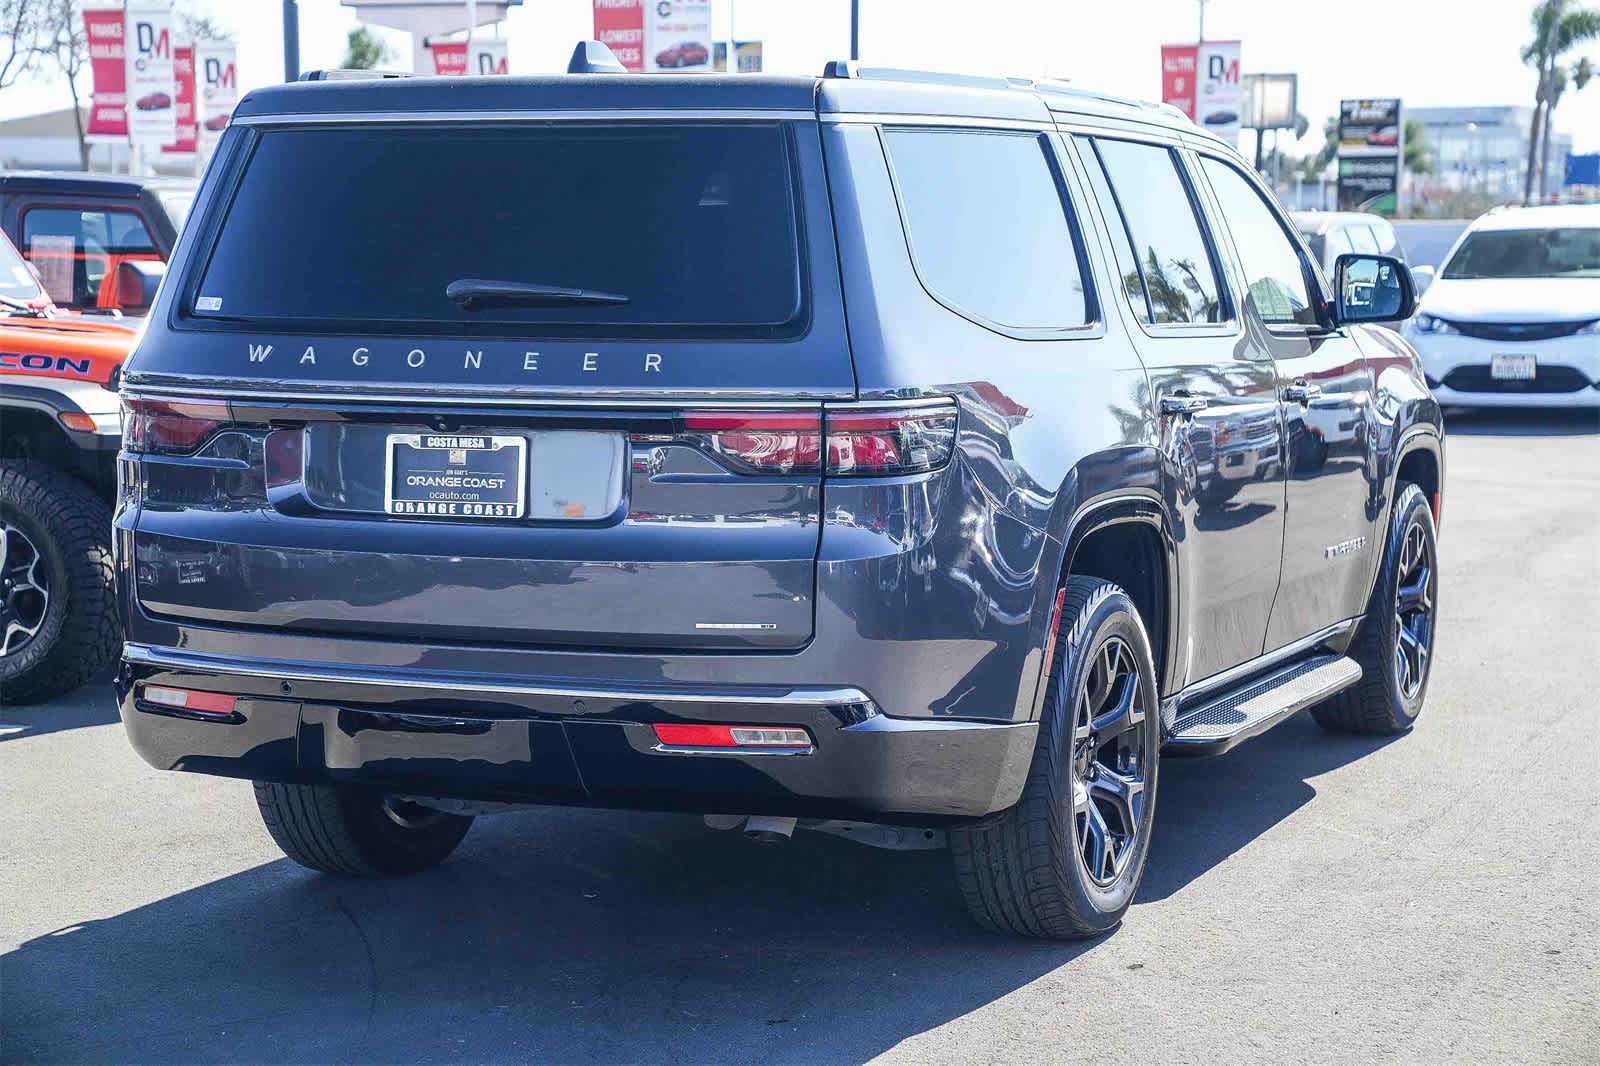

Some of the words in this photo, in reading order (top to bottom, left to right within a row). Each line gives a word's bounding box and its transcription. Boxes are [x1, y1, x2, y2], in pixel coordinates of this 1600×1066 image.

[249, 343, 662, 372] WAGONEER
[427, 437, 458, 448] COSTA
[459, 438, 485, 448] MESA
[407, 475, 461, 487] ORANGE
[463, 477, 506, 489] COAST
[429, 491, 480, 500] ocauto.com
[395, 501, 456, 513] ORANGE
[463, 504, 514, 515] COAST
